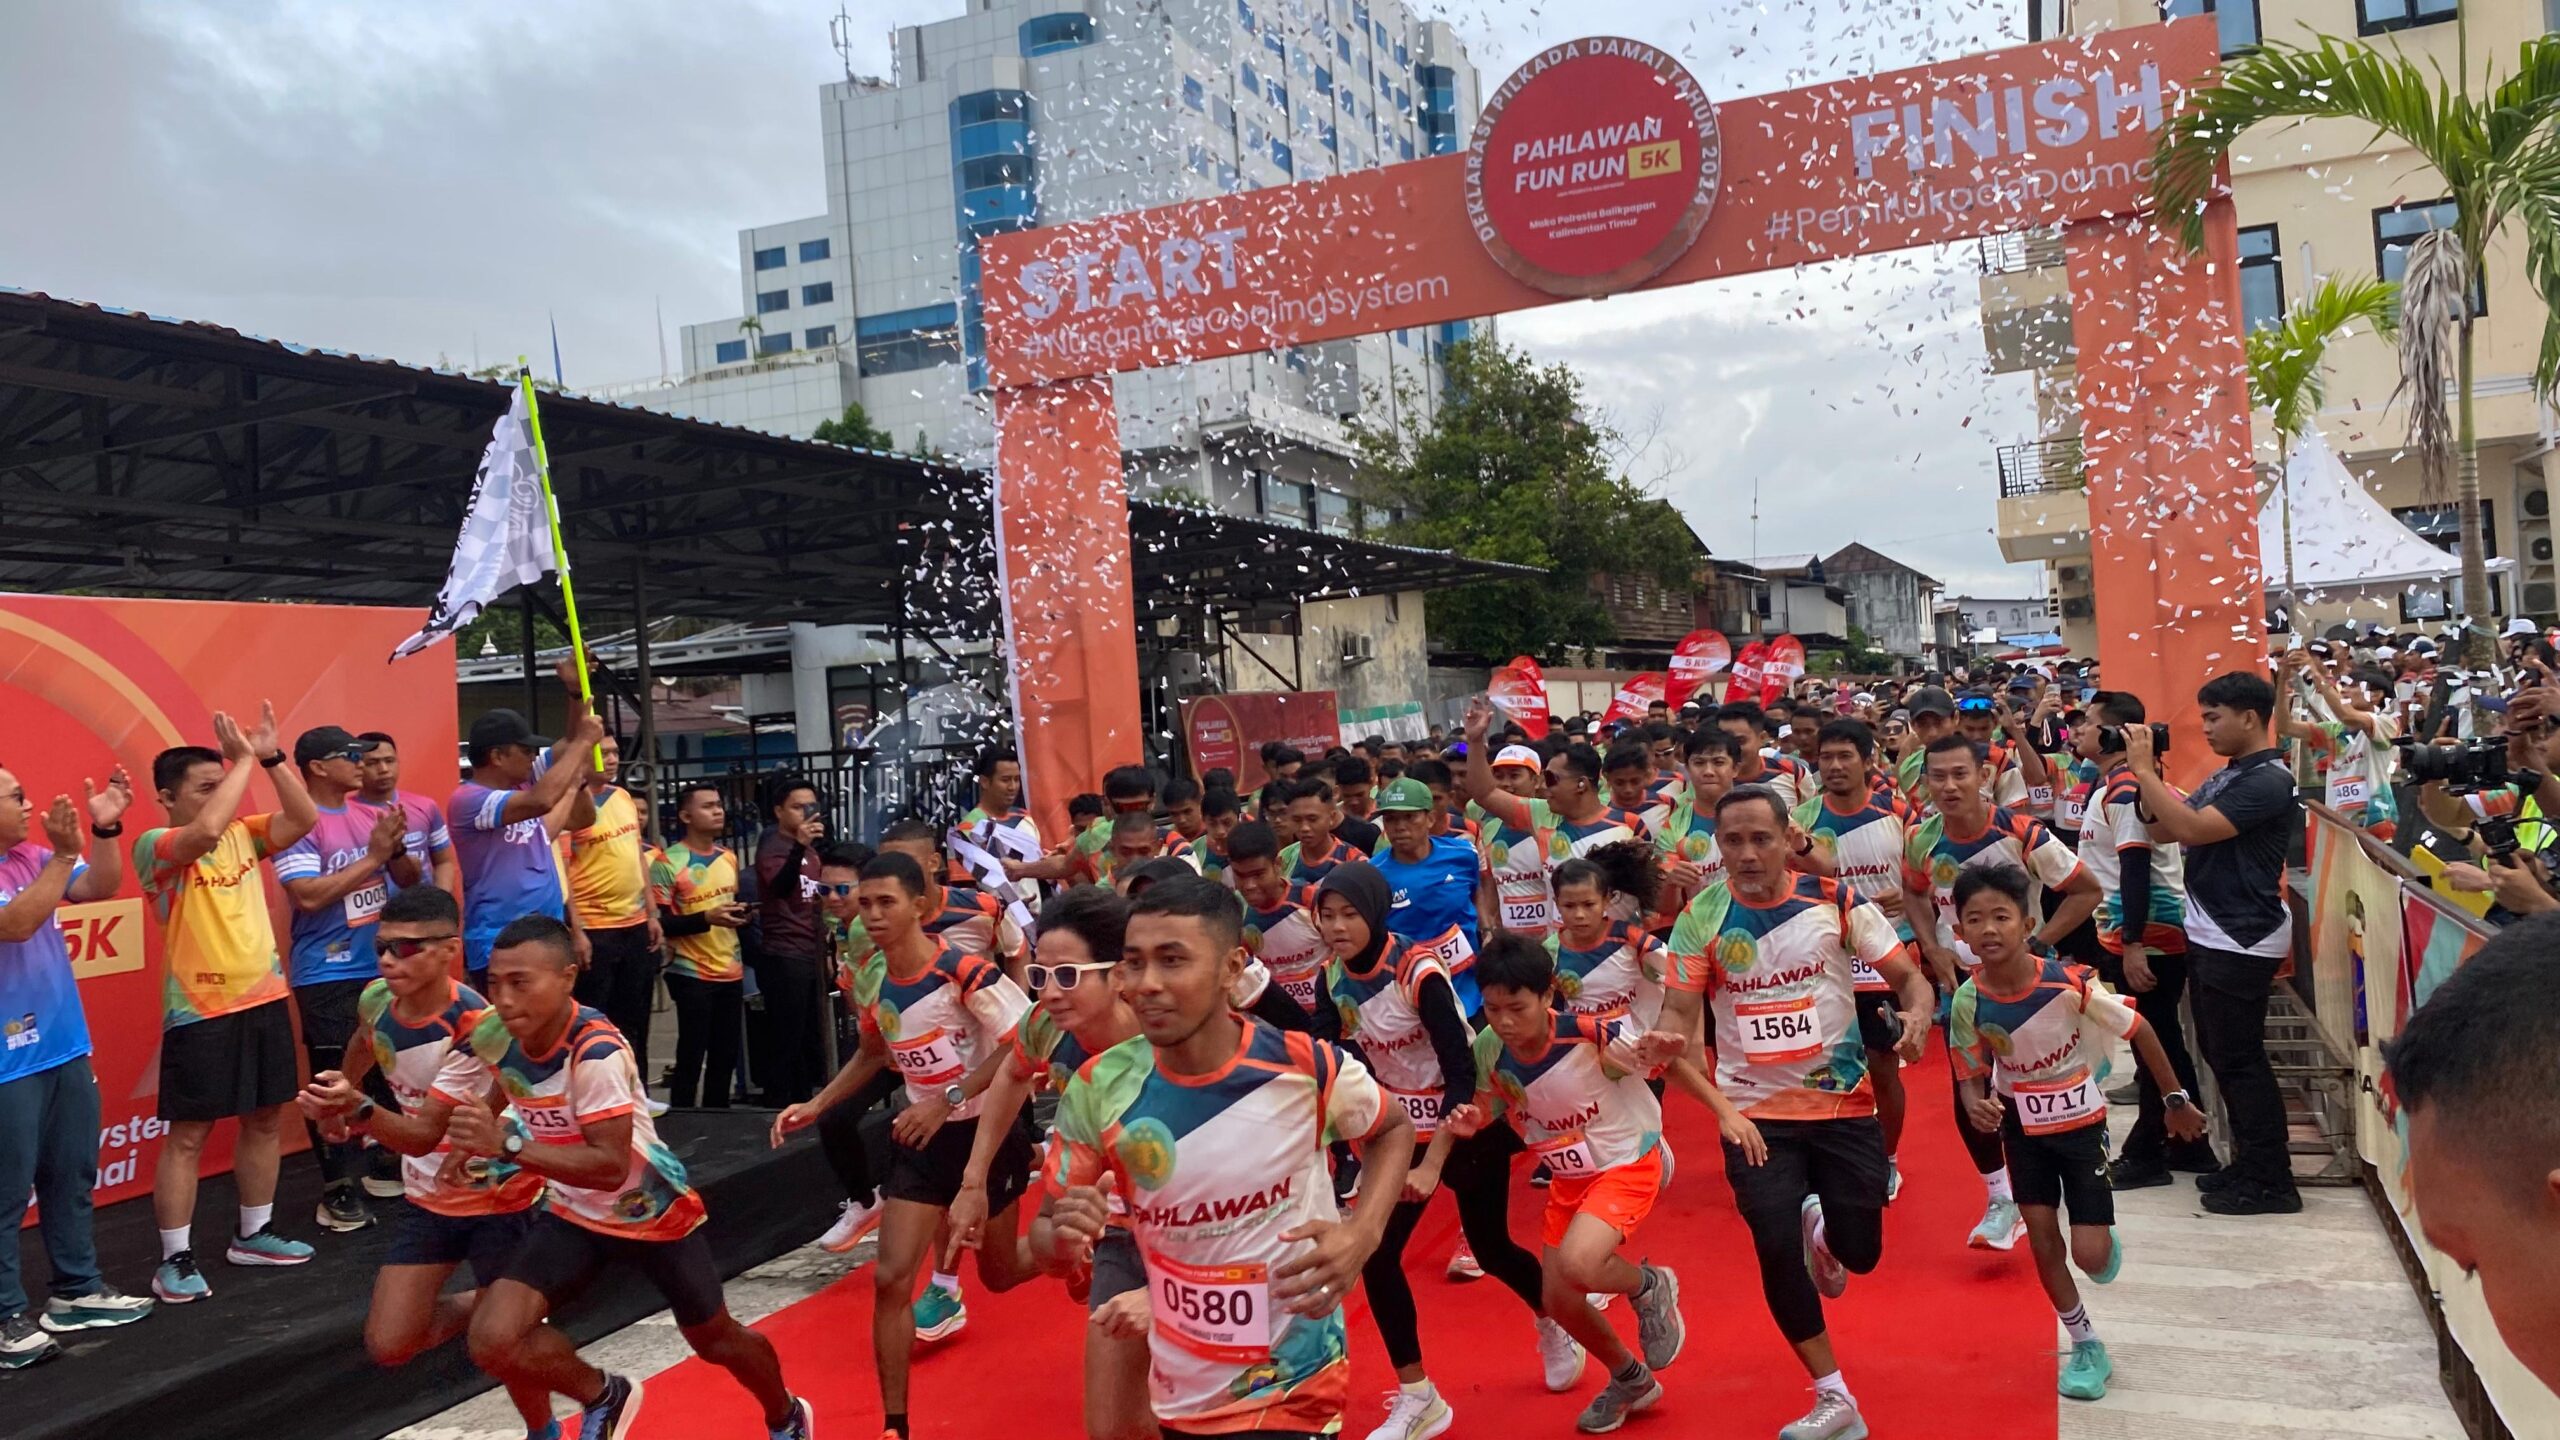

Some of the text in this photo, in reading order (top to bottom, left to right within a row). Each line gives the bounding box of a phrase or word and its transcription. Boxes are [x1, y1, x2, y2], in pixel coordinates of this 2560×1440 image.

[1467, 114, 1496, 242] DEKLARASI
[1491, 43, 1580, 111] PILKADA
[1589, 39, 1666, 71] DAMAI
[1668, 64, 1714, 138] TAHUN
[1513, 118, 1662, 164] PAHLAWAN
[1851, 61, 2163, 180] FINISH
[1515, 169, 1564, 193] FUN
[1571, 155, 1625, 184] RUN
[1639, 147, 1670, 170] 5K
[1599, 201, 1656, 217] Balikpapan
[1764, 158, 2160, 241] #PemilukadaDama
[1549, 218, 1638, 239] Kalimantan Timur
[1019, 226, 1248, 319] START
[1508, 904, 1546, 920] 1220
[60, 915, 124, 962] 5K
[1440, 938, 1460, 960] 57
[196, 972, 226, 986] #NCS
[1726, 961, 1826, 994] PAHLAWAN
[1750, 1014, 1812, 1041] 1564
[2026, 1084, 2087, 1115] 0717
[1132, 1176, 1291, 1227] PAHLAWAN
[1164, 1278, 1253, 1326] 0580
